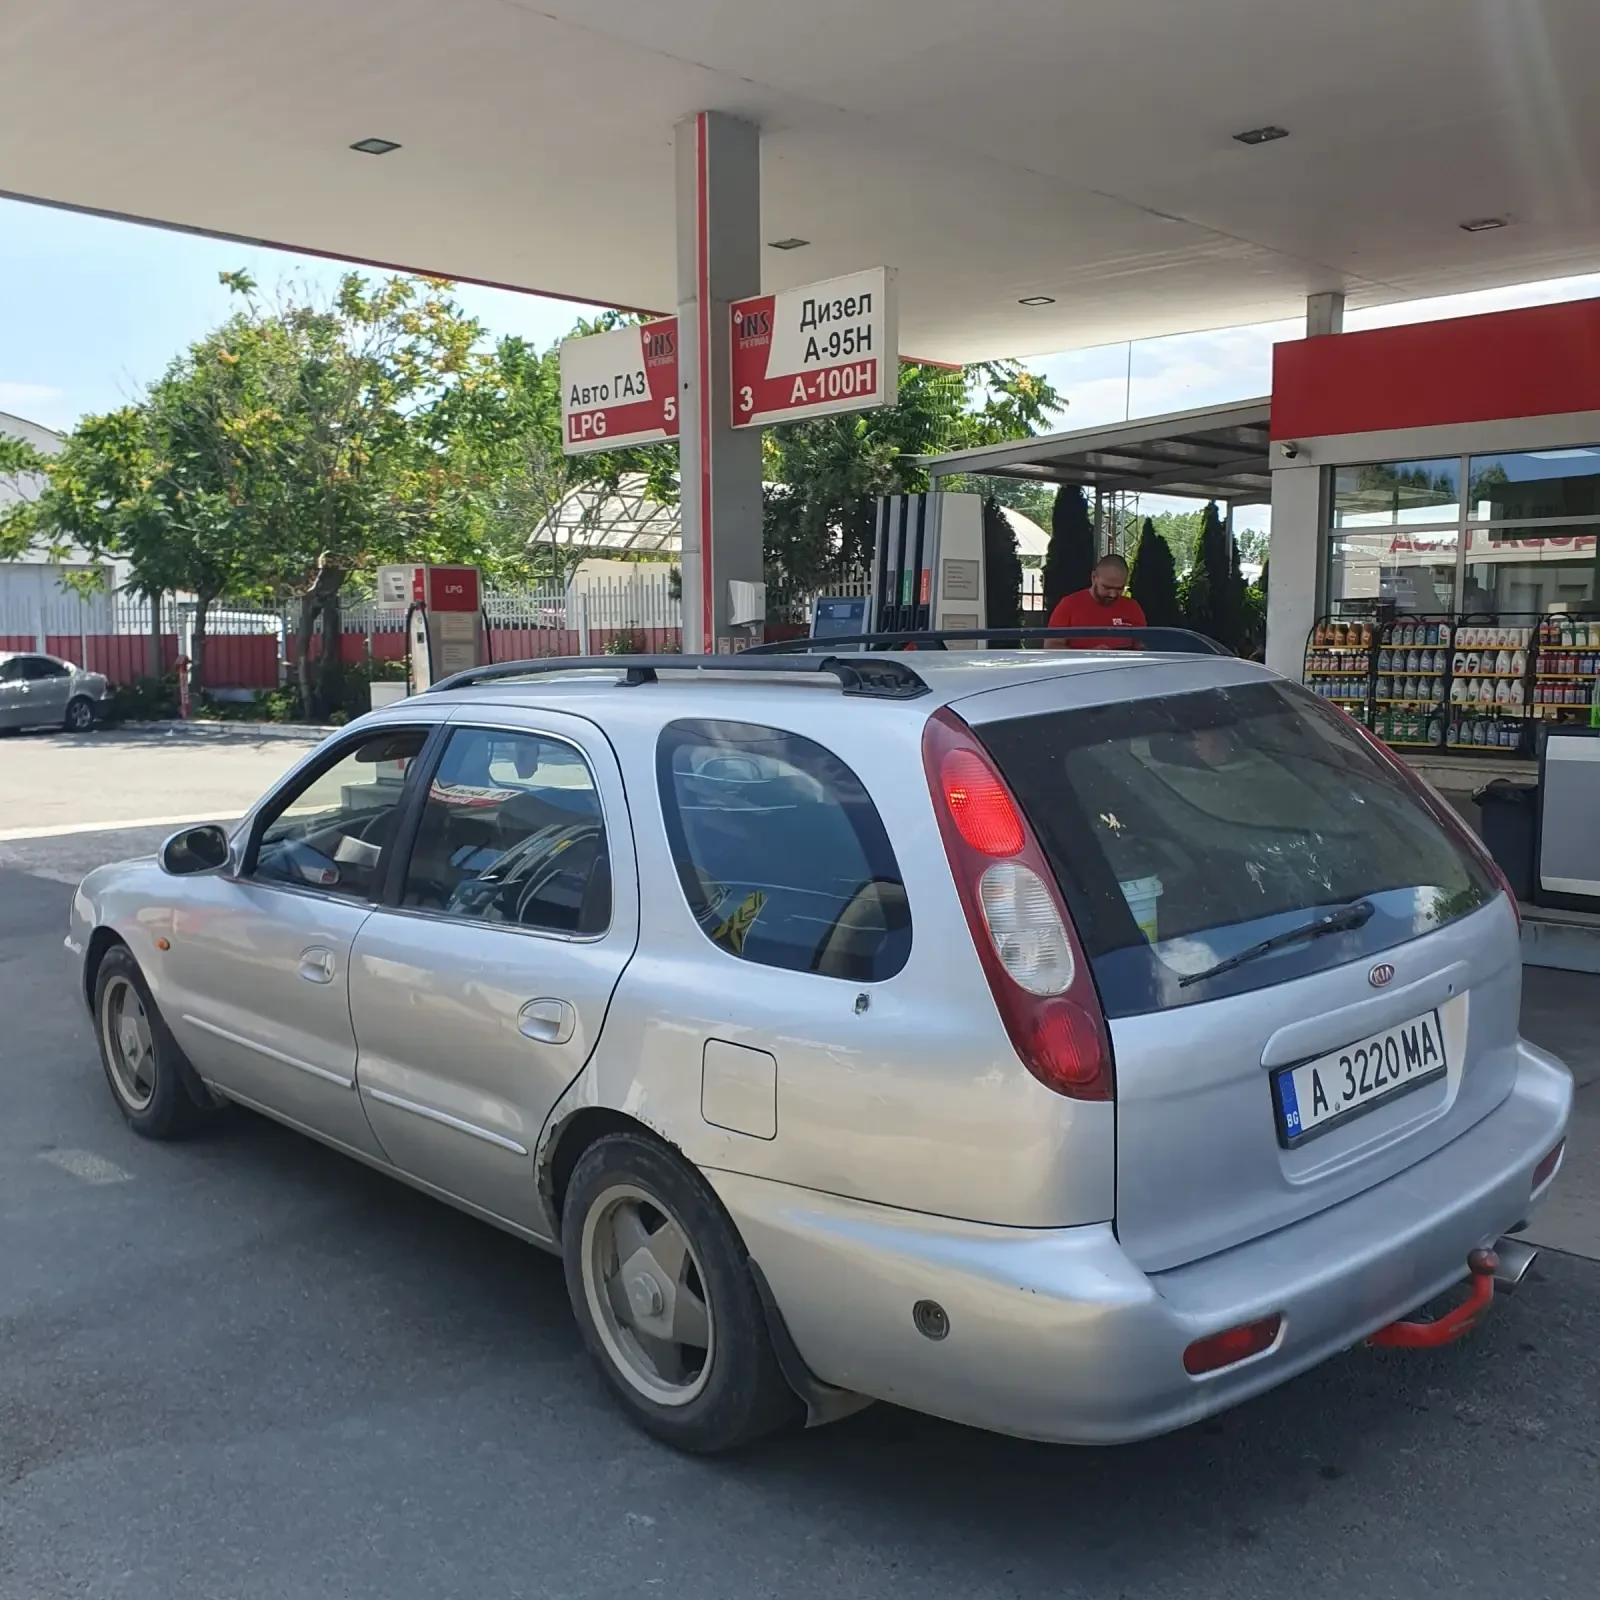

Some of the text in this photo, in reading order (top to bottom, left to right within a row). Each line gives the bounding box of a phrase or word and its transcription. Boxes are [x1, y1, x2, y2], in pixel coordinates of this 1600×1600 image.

[740, 310, 769, 338] INS
[800, 293, 872, 332] Дизел
[647, 332, 675, 357] INS
[570, 371, 646, 407] Авто ГАЗ
[739, 385, 754, 412] 3
[663, 396, 676, 421] 5
[571, 412, 607, 439] LPG
[445, 585, 463, 594] LPG
[1372, 965, 1393, 984] KIA
[1339, 1036, 1400, 1101] 3220
[1286, 1111, 1299, 1128] BG
